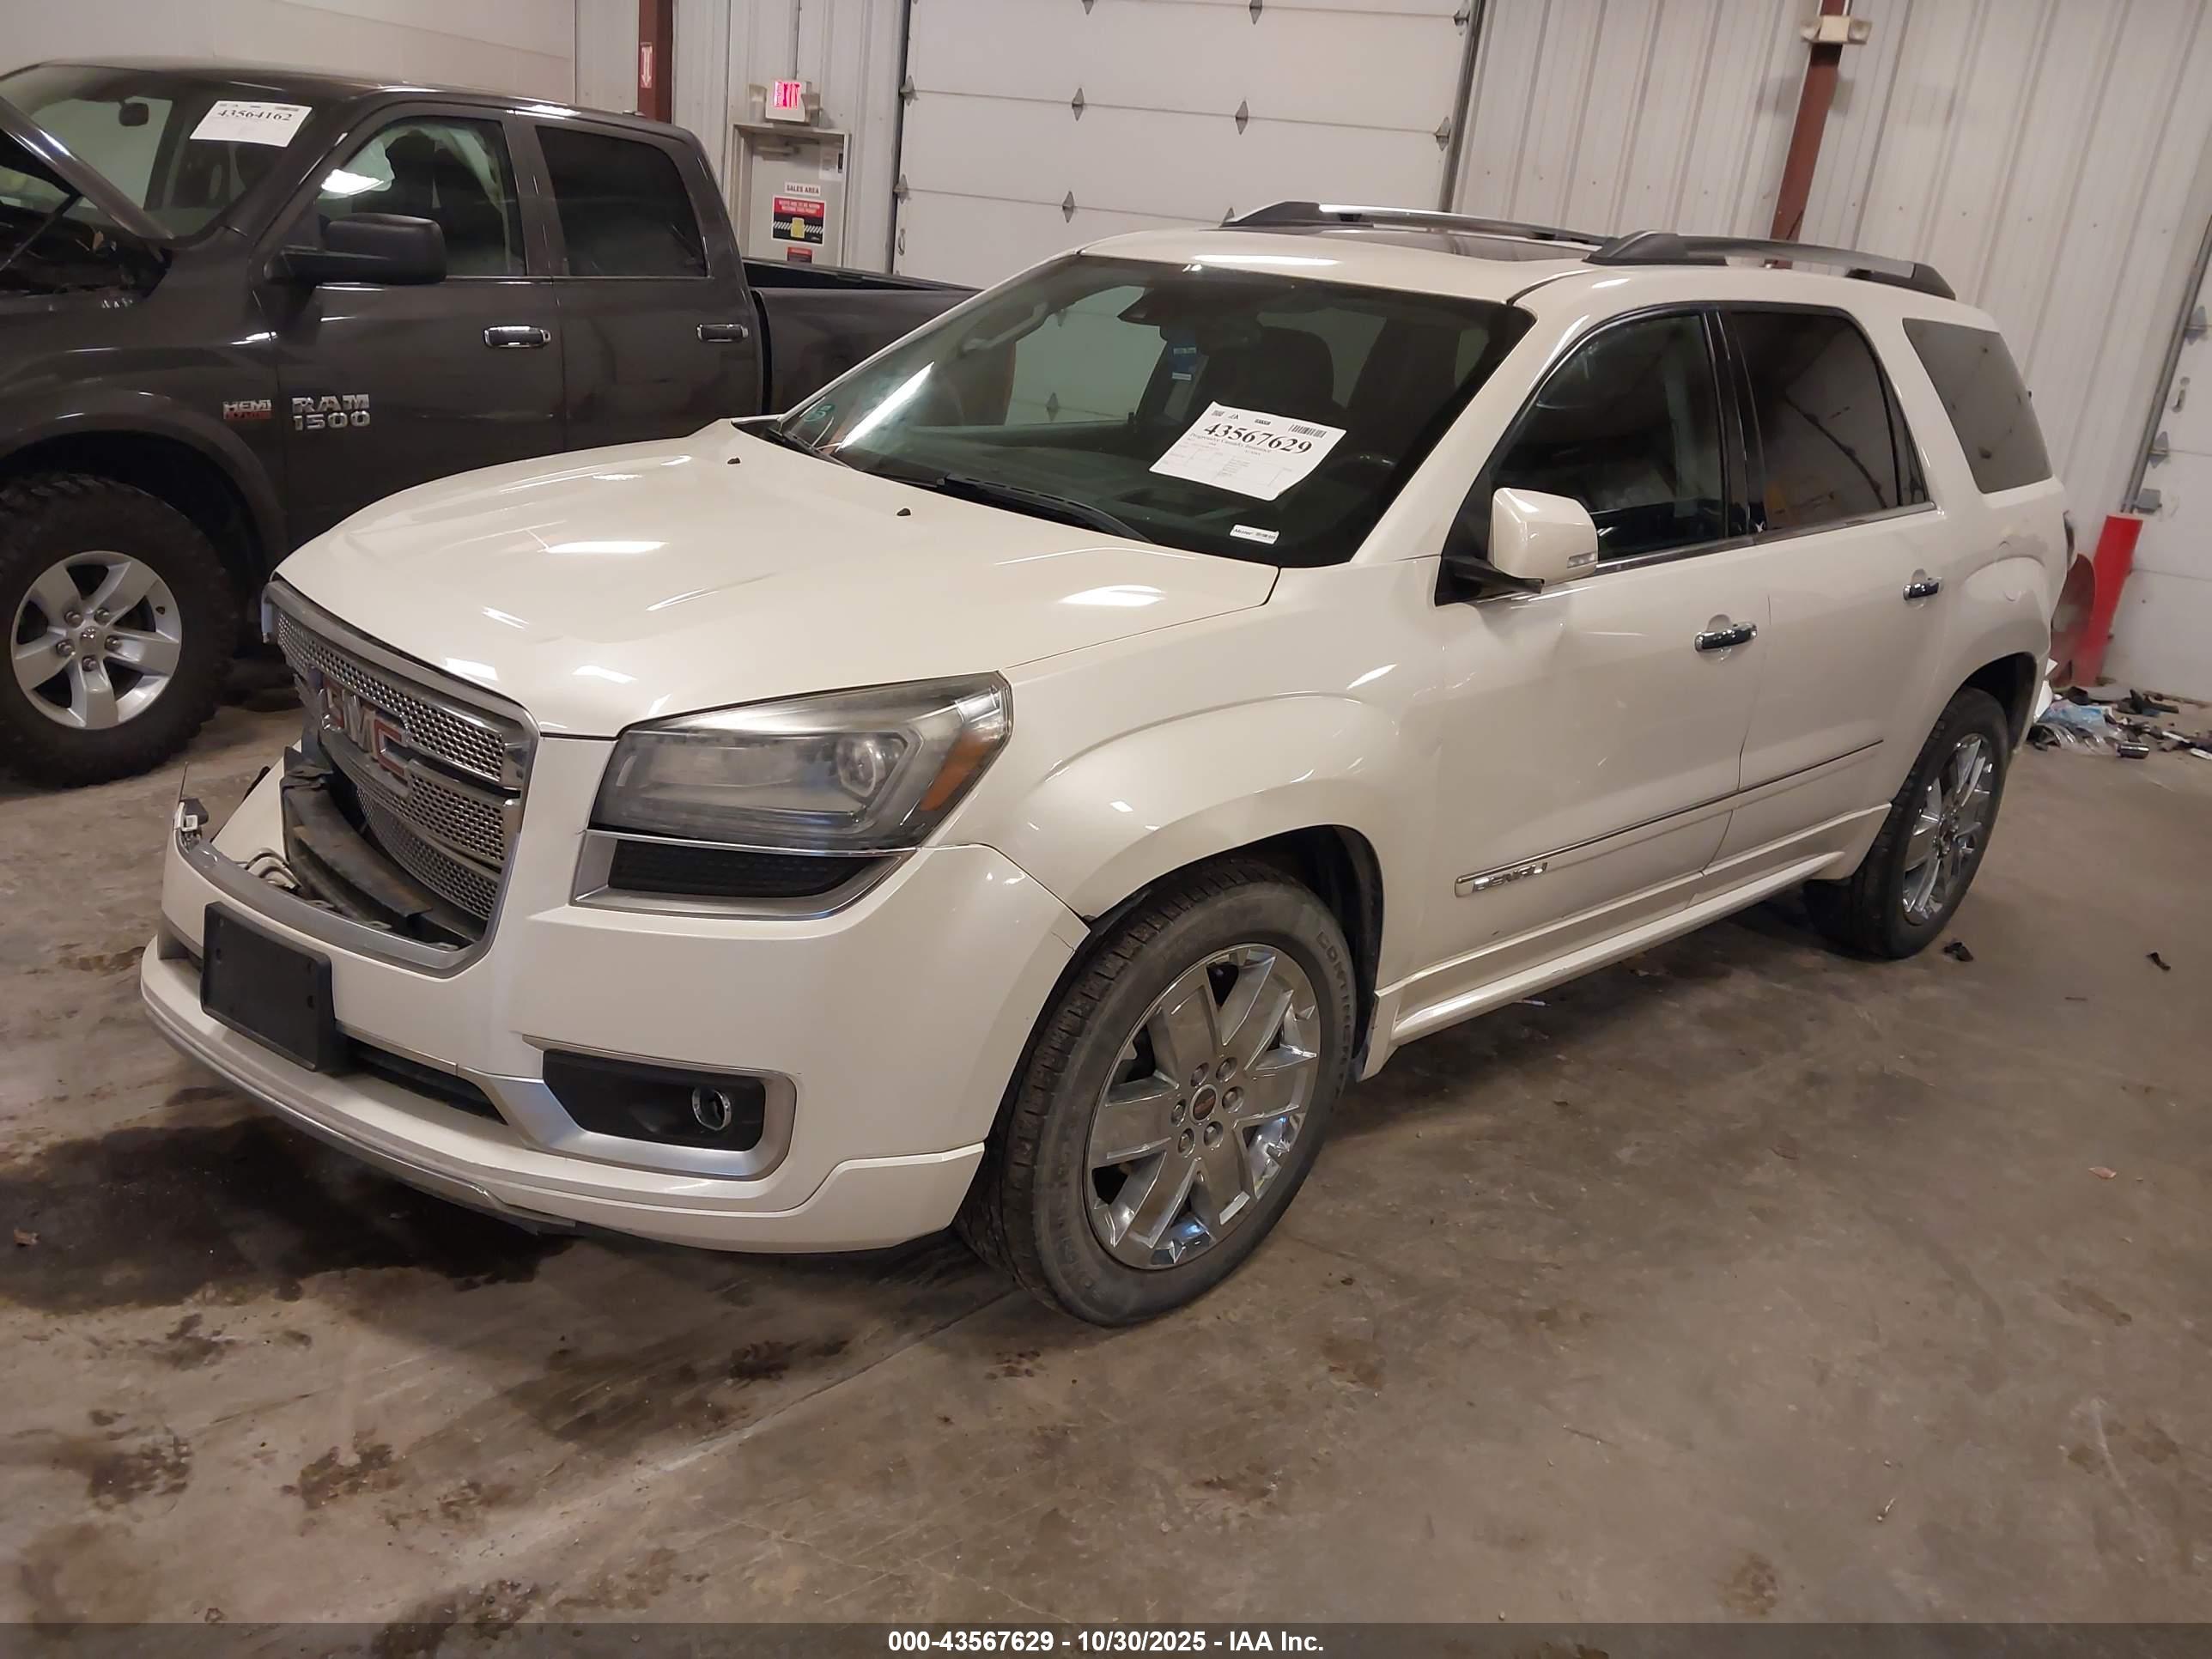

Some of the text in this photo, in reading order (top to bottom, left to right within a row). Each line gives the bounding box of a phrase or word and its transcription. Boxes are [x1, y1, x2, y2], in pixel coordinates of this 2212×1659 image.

[218, 109, 292, 121] 43564162
[787, 185, 803, 193] SALES
[223, 399, 271, 413] HEMI
[292, 394, 369, 413] RAM
[293, 410, 370, 430] 1500
[1205, 422, 1312, 454] 43567629
